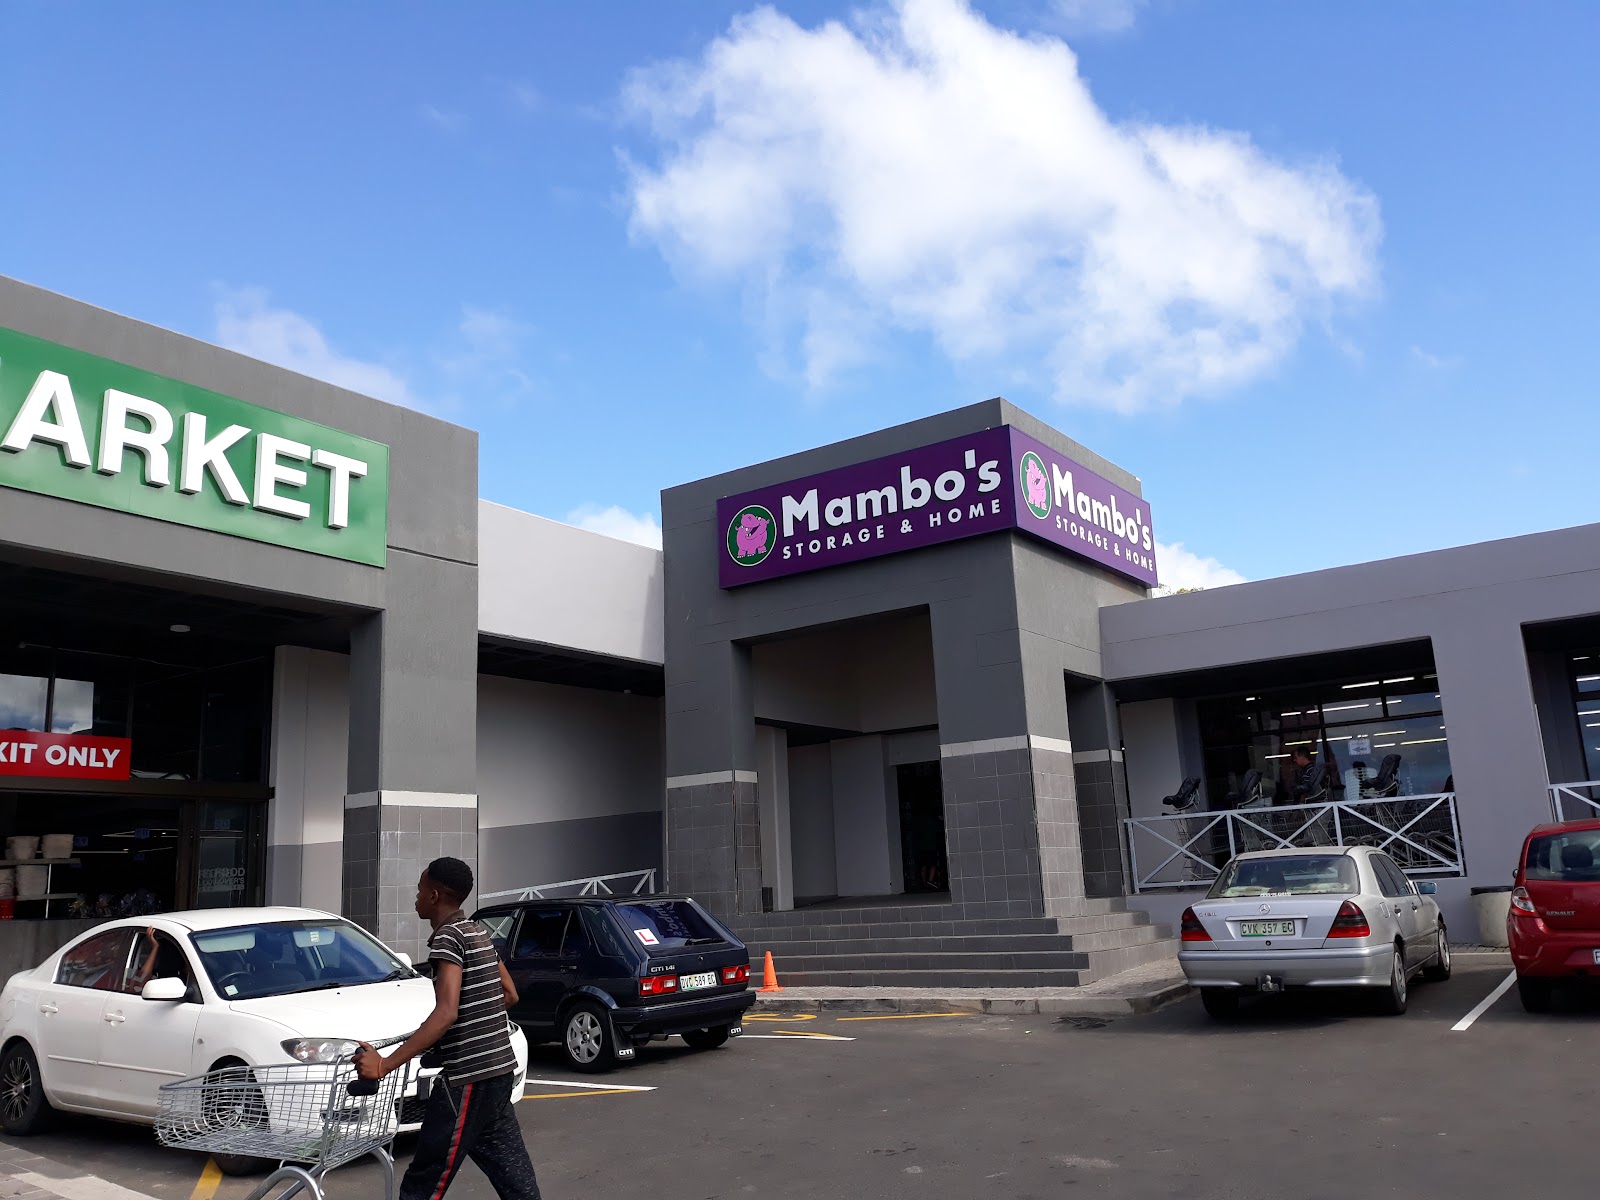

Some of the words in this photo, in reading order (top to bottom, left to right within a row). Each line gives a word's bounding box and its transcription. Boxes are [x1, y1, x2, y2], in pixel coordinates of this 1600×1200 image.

[0, 369, 368, 530] ARKET
[781, 449, 1001, 538] Mambo's
[1052, 463, 1152, 551] Mambo's
[782, 525, 885, 559] STORAGE
[900, 518, 913, 534] &
[929, 499, 1001, 527] HOME
[1055, 515, 1109, 551] STORAGE
[1113, 542, 1121, 556] &
[1125, 548, 1154, 572] HOME
[45, 744, 120, 768] ONLY
[638, 931, 655, 943] L
[1241, 923, 1258, 934] CVK
[1262, 923, 1278, 934] 357
[1282, 922, 1293, 933] EC
[694, 975, 706, 987] 589
[707, 973, 716, 985] EC
